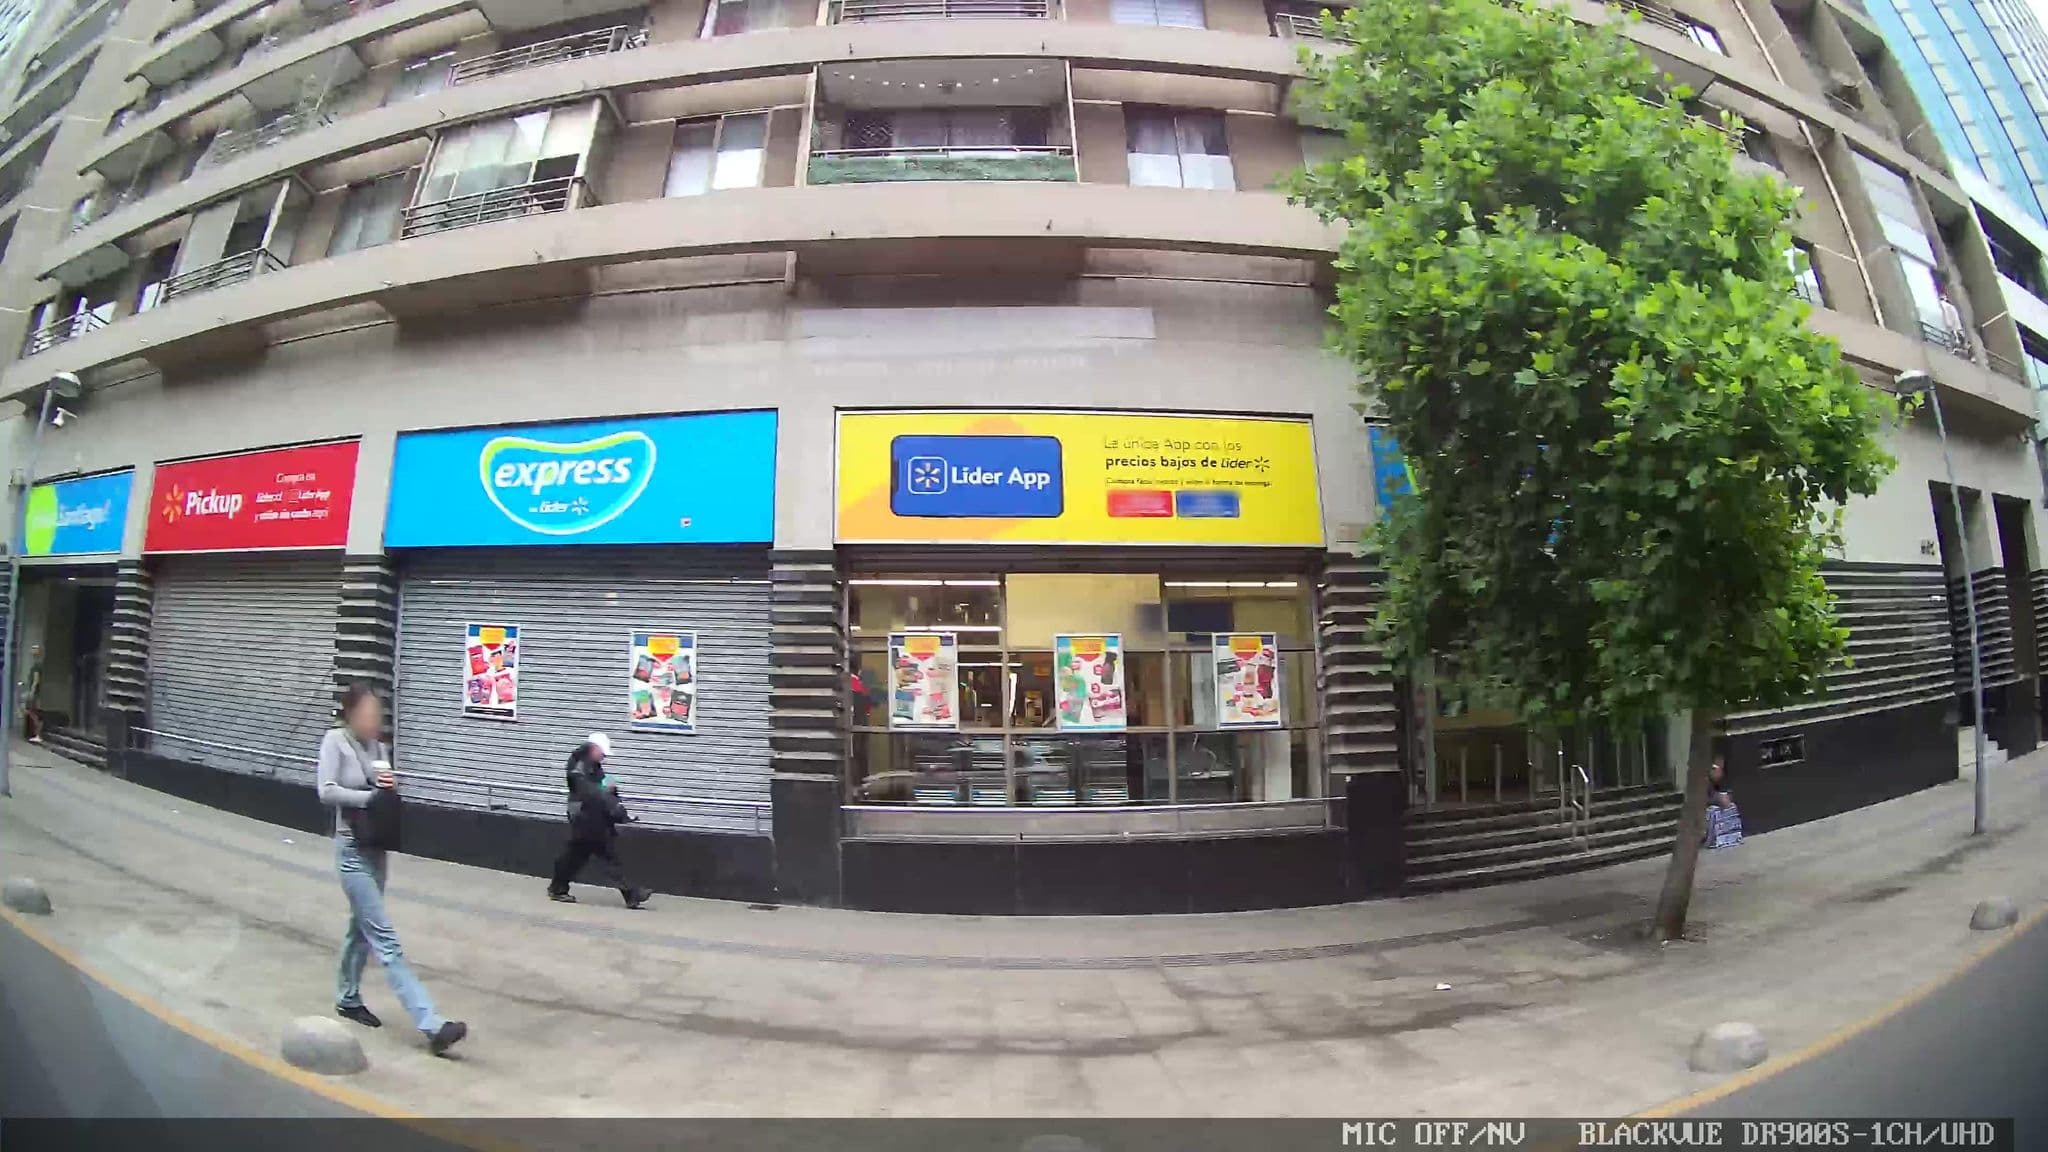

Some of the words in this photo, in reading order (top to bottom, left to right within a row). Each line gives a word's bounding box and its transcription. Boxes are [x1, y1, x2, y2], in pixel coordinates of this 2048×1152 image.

[1164, 439, 1191, 453] App
[1105, 455, 1157, 470] precios
[1160, 455, 1197, 471] bajos
[1201, 456, 1217, 468] de
[494, 456, 633, 496] express
[1007, 467, 1051, 491] App
[185, 488, 243, 520] Pickup
